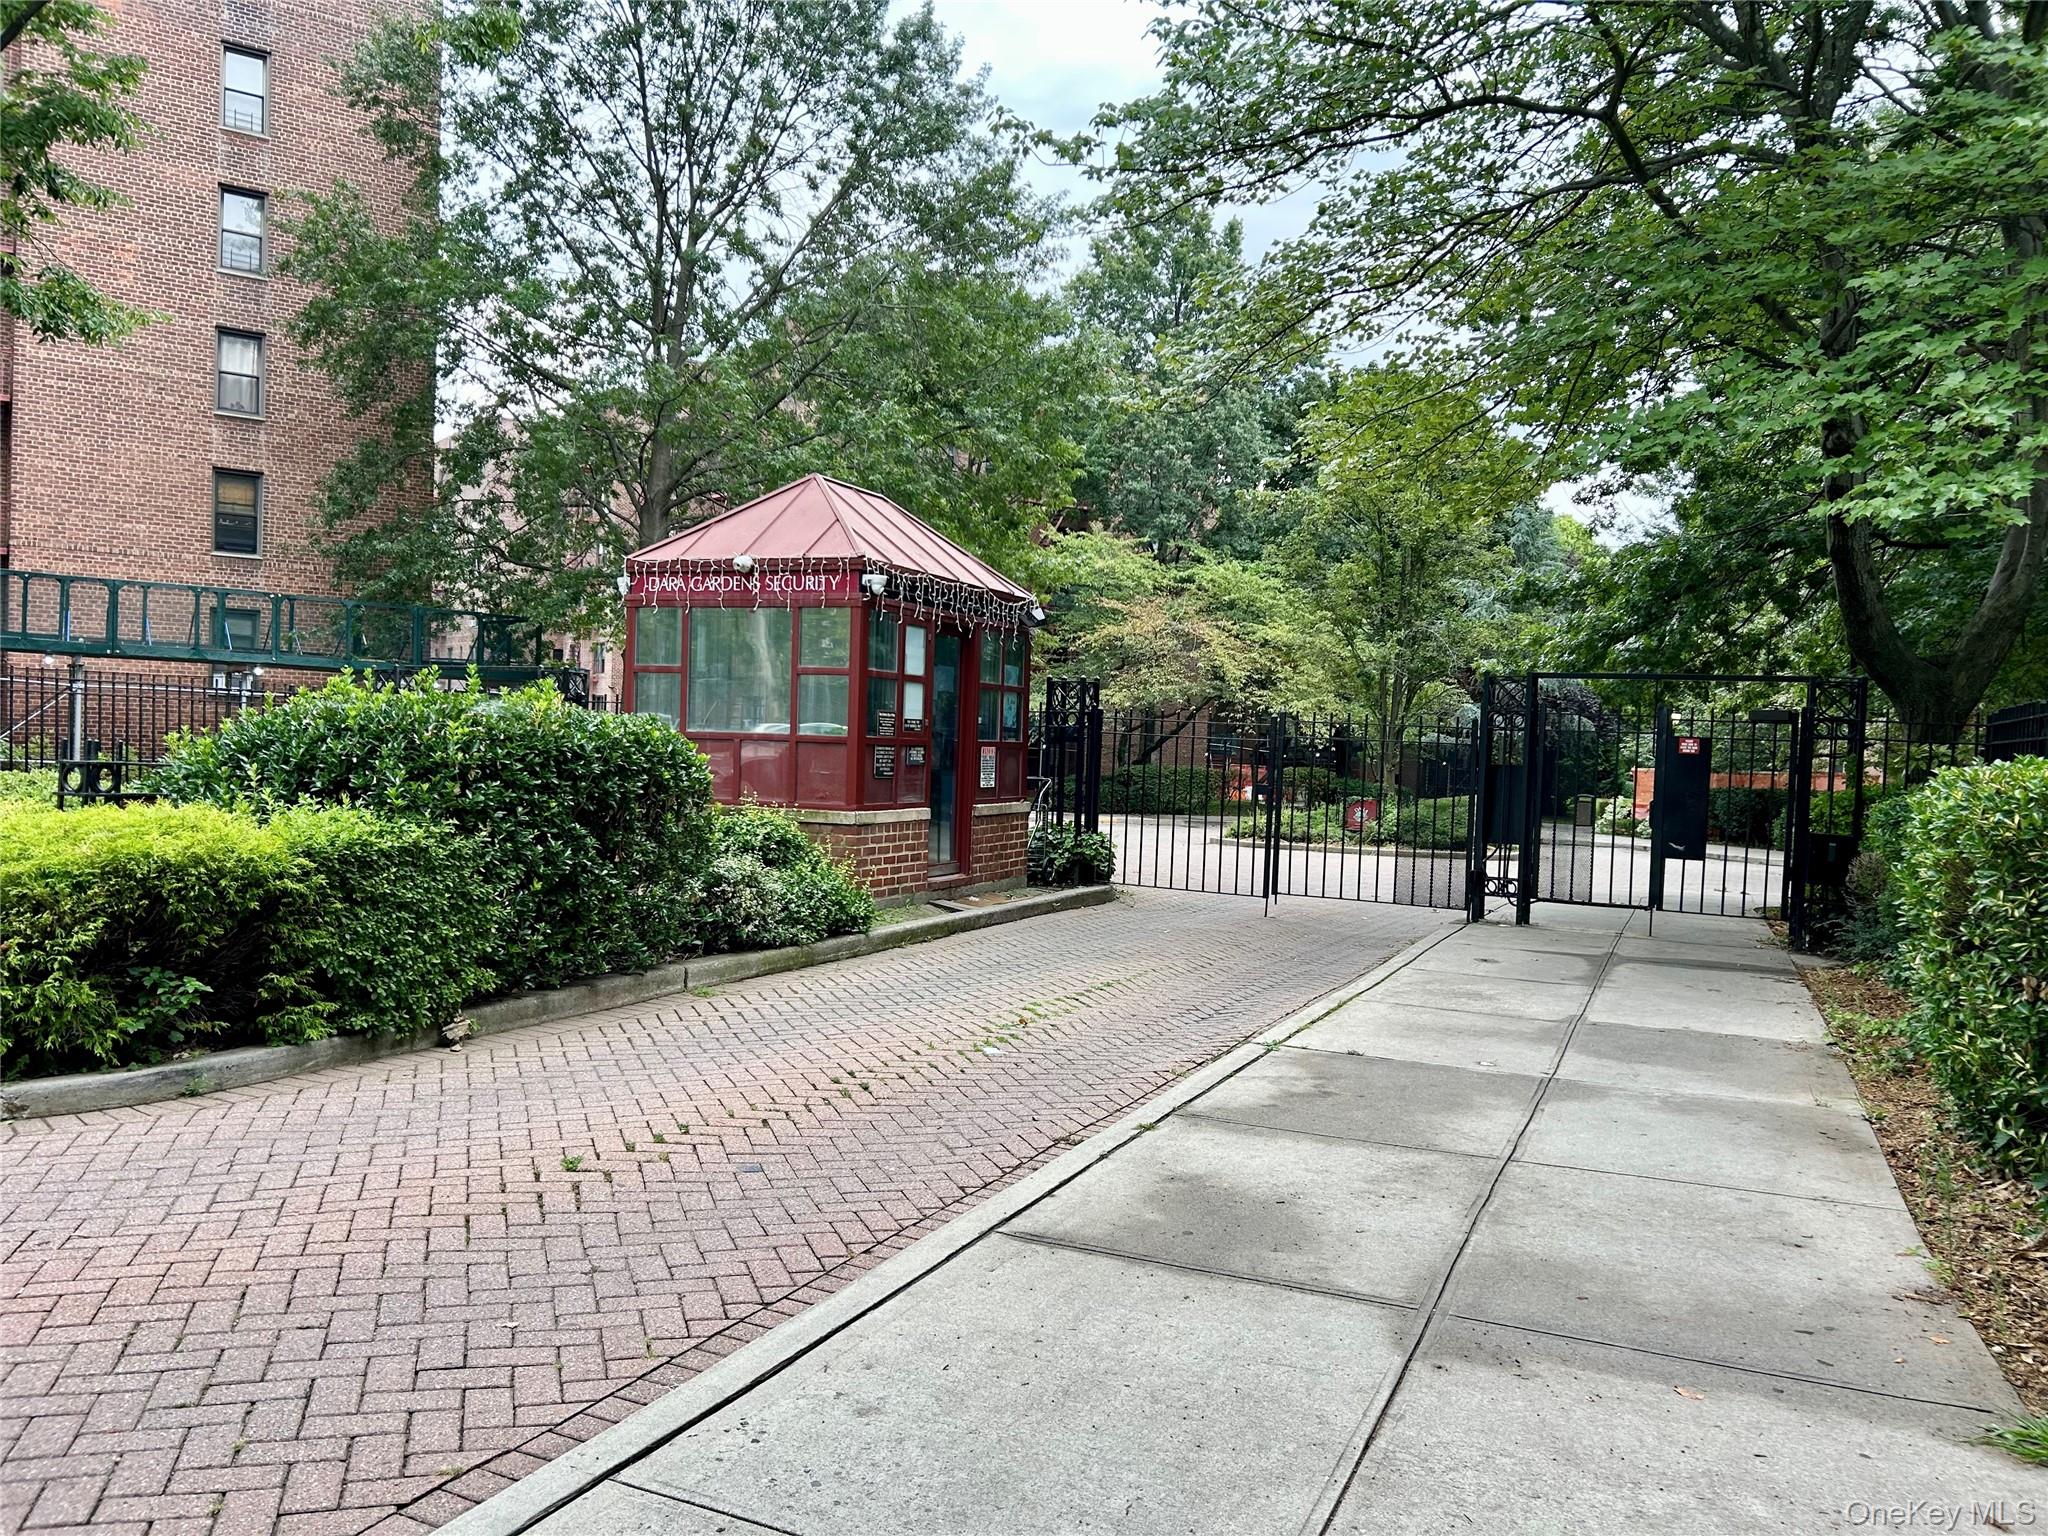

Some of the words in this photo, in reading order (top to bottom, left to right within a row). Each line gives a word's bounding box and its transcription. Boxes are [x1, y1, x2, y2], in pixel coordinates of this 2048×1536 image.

[649, 575, 686, 592] DARA
[691, 575, 759, 592] GARDENS
[765, 575, 839, 591] SECURITY
